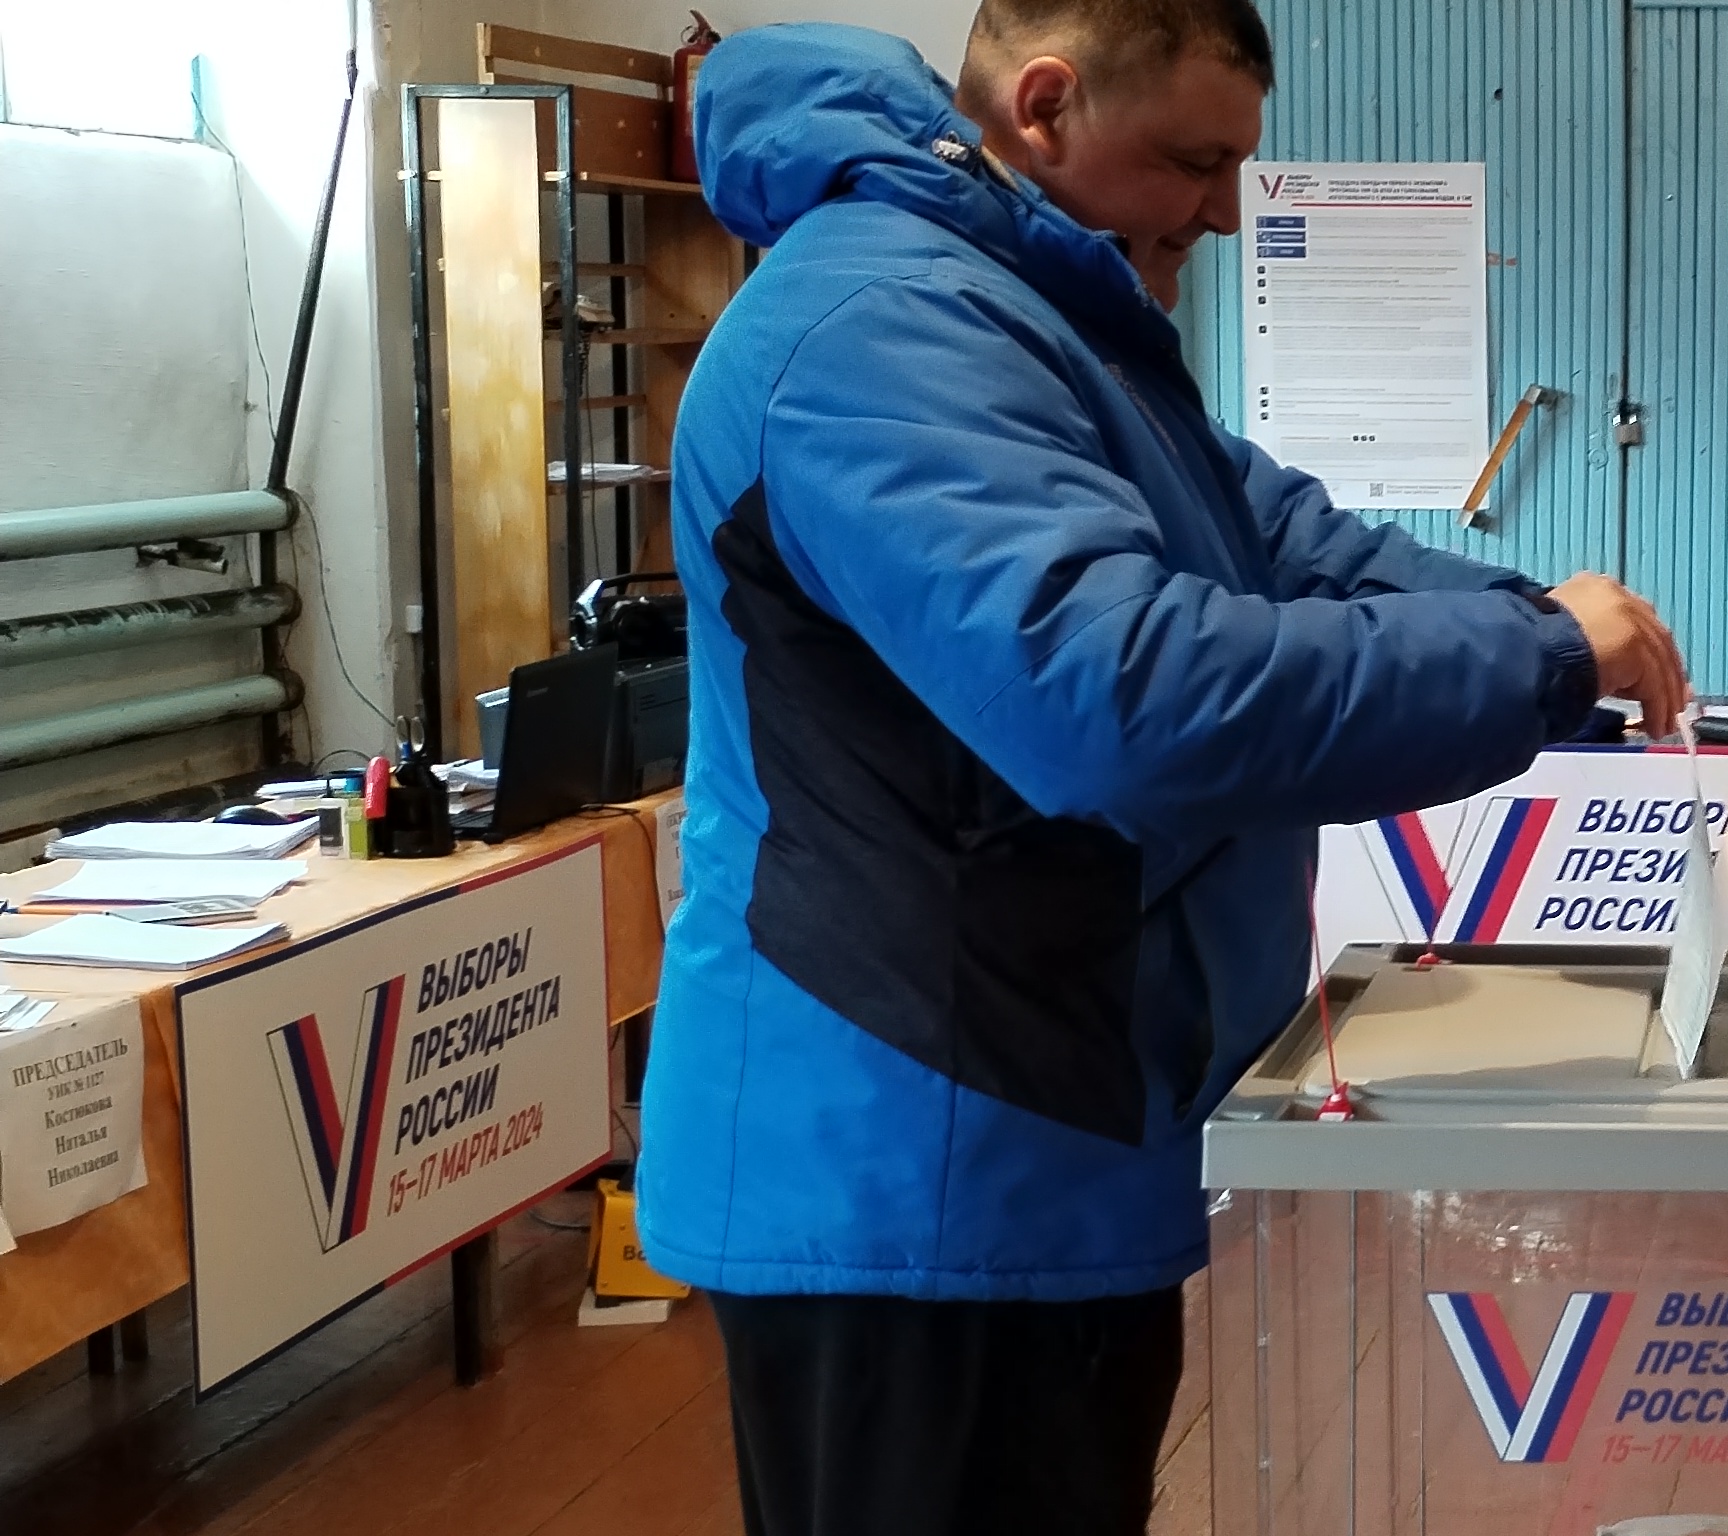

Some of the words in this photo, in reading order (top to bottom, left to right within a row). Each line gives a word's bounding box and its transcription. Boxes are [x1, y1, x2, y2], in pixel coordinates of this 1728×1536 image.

[417, 926, 533, 1014] ВЫБОРЫ
[12, 1038, 128, 1087] ПРЕДСЕДАТЕЛЬ
[405, 975, 561, 1084] ПРЕЗИДЕНТА
[48, 1079, 71, 1101] УИК
[394, 1063, 500, 1155] РОССИИ
[48, 1150, 119, 1188] Николаевна
[55, 1126, 108, 1155] Наталья
[438, 1122, 500, 1189] МАРТА
[501, 1101, 543, 1157] 2024
